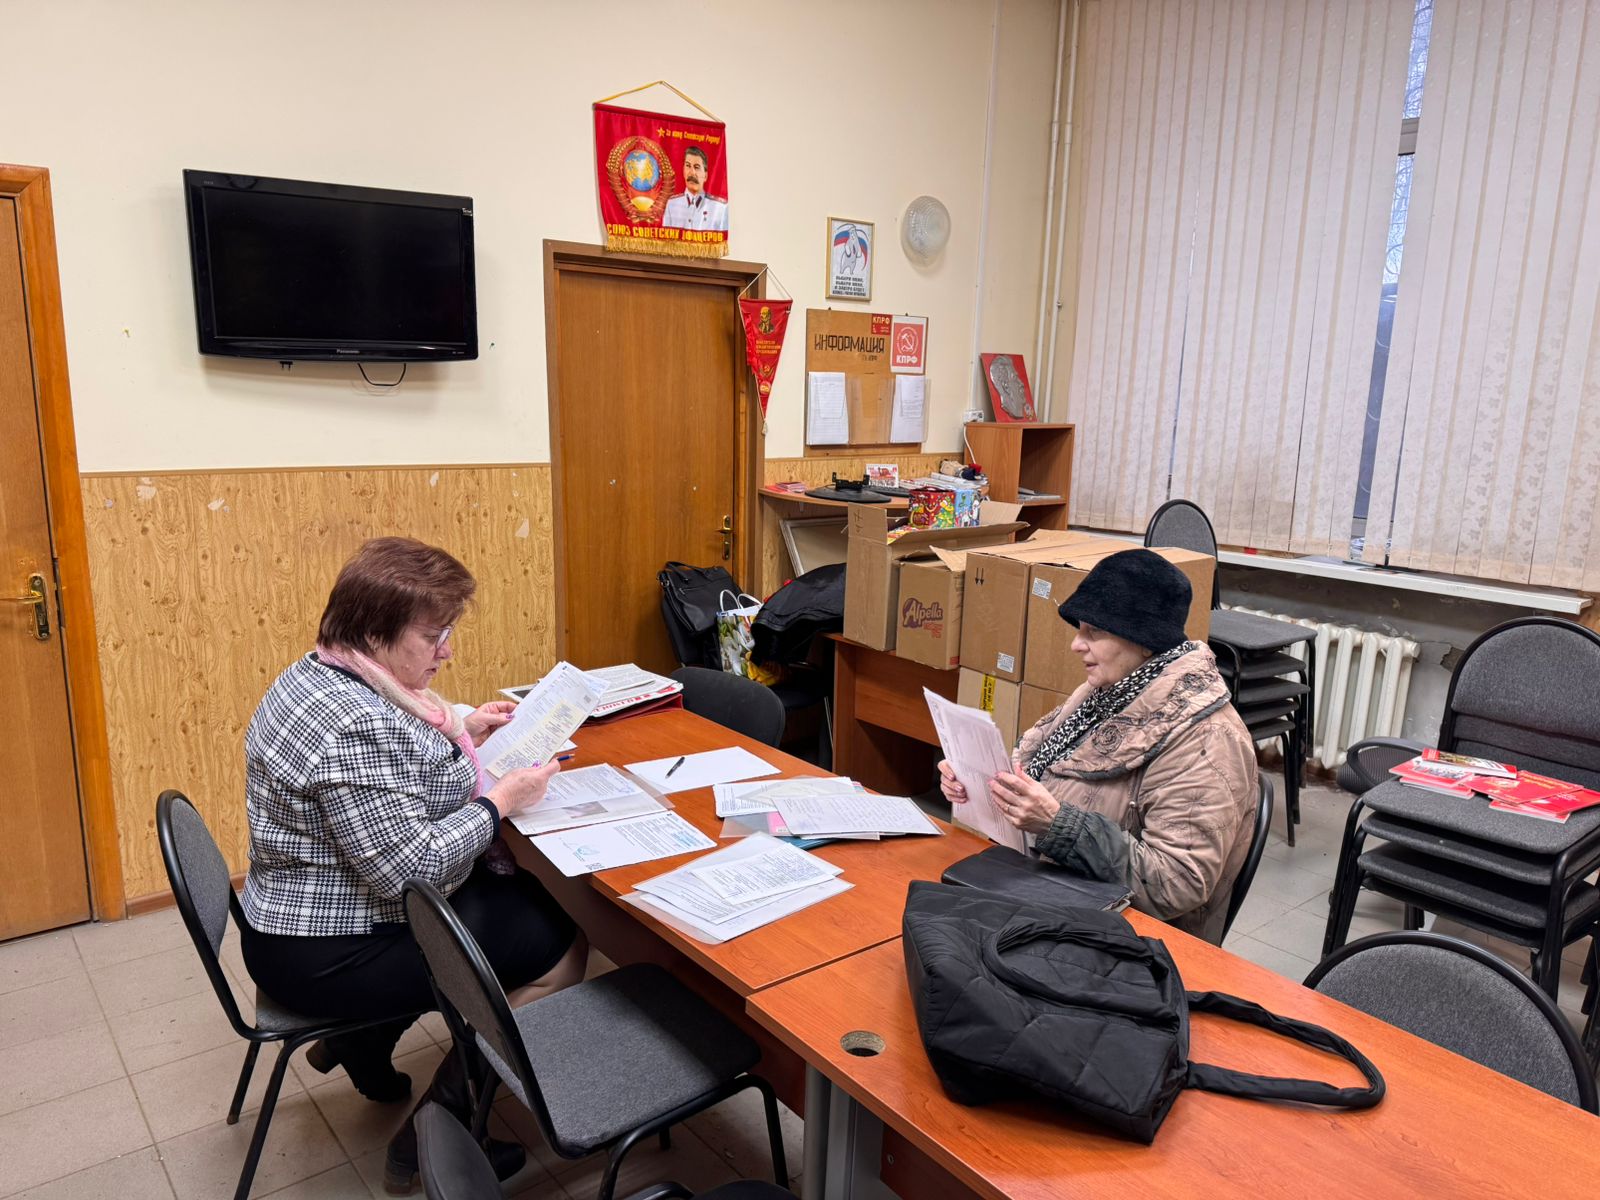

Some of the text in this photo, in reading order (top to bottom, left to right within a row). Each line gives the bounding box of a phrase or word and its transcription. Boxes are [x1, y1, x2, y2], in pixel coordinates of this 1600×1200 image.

[607, 223, 631, 236] СОЮЗ
[633, 226, 680, 239] СОВЕТСКИХ
[873, 316, 890, 325] КПРФ
[815, 334, 884, 353] ИНФОРМАЦИЯ
[896, 354, 918, 364] КПРФ
[903, 599, 943, 628] Alpella
